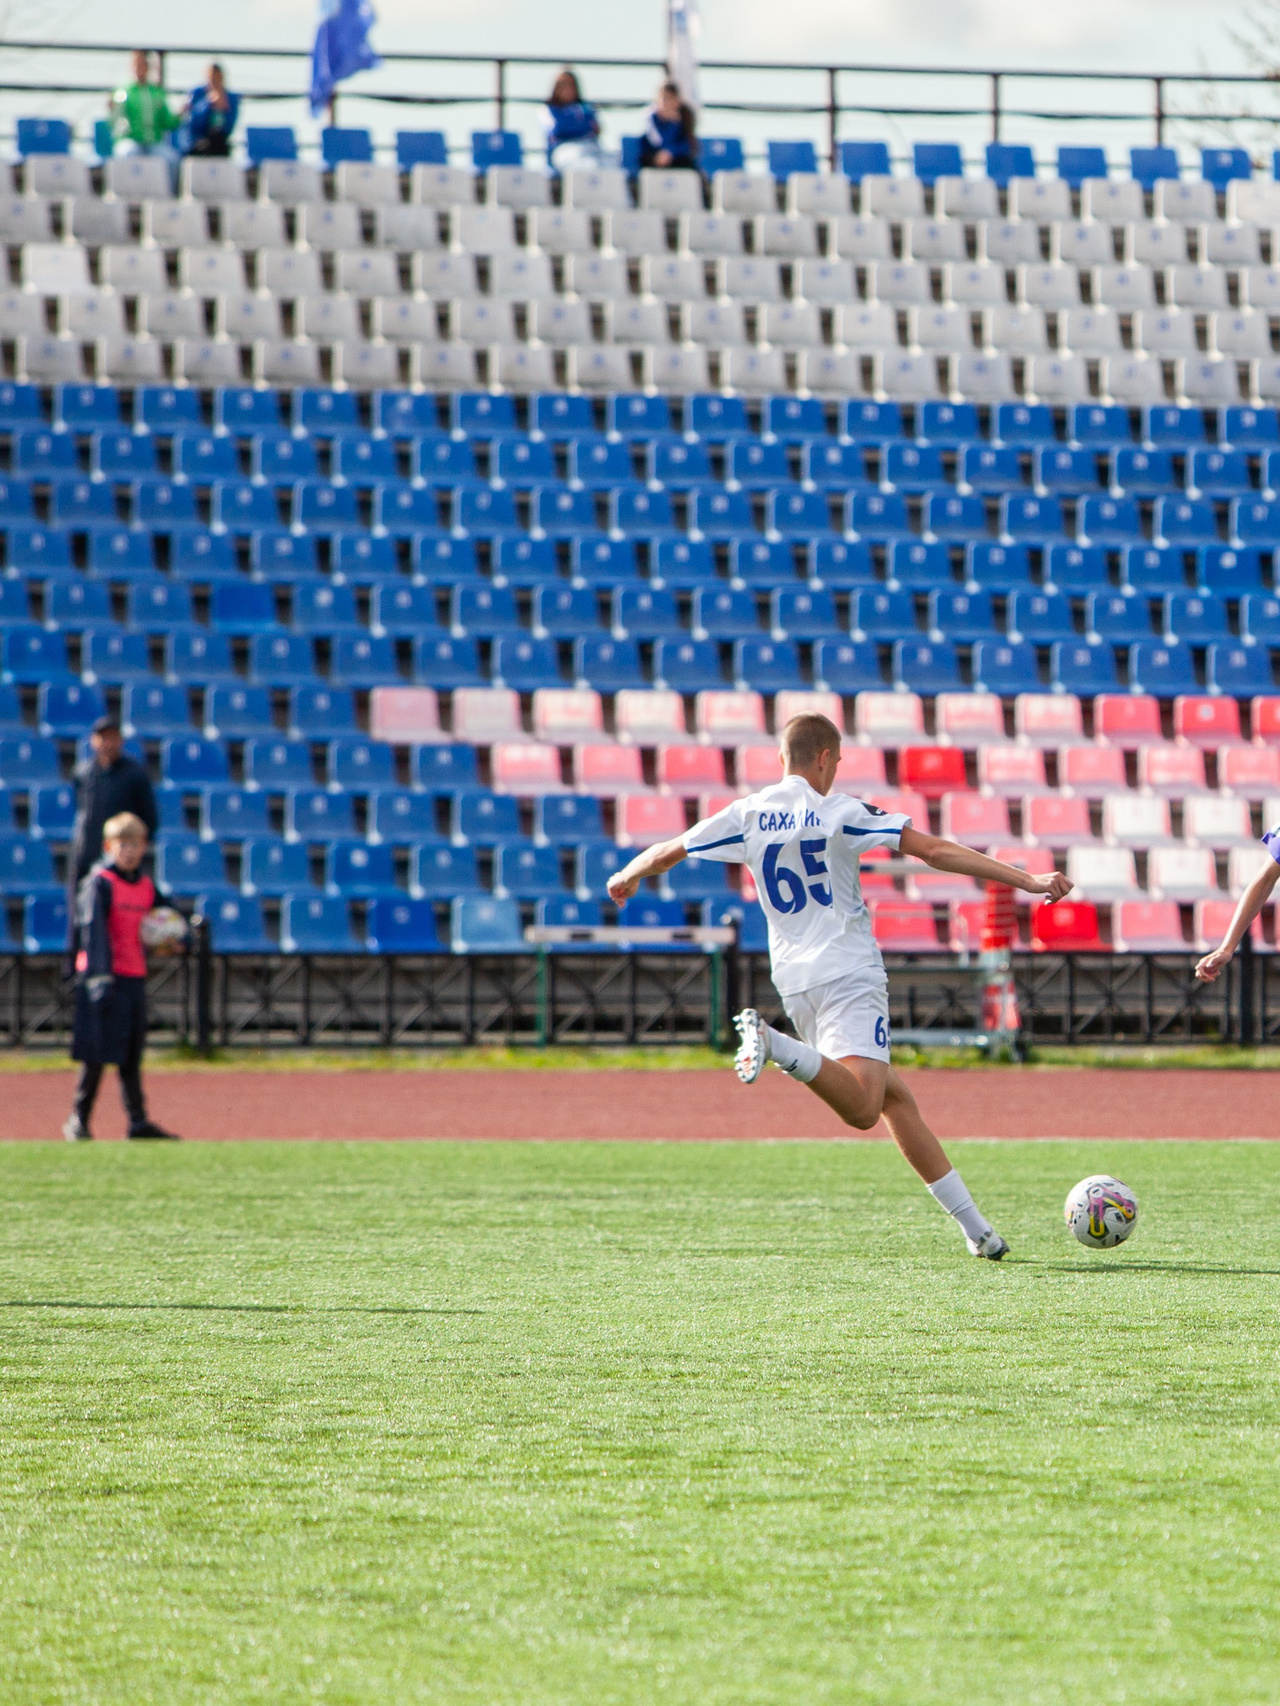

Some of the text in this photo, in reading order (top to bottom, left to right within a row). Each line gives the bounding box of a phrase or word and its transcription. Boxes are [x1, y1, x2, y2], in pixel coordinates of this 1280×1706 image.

[759, 808, 825, 832] САХАИ
[762, 838, 833, 914] 65
[874, 1015, 891, 1051] 6
